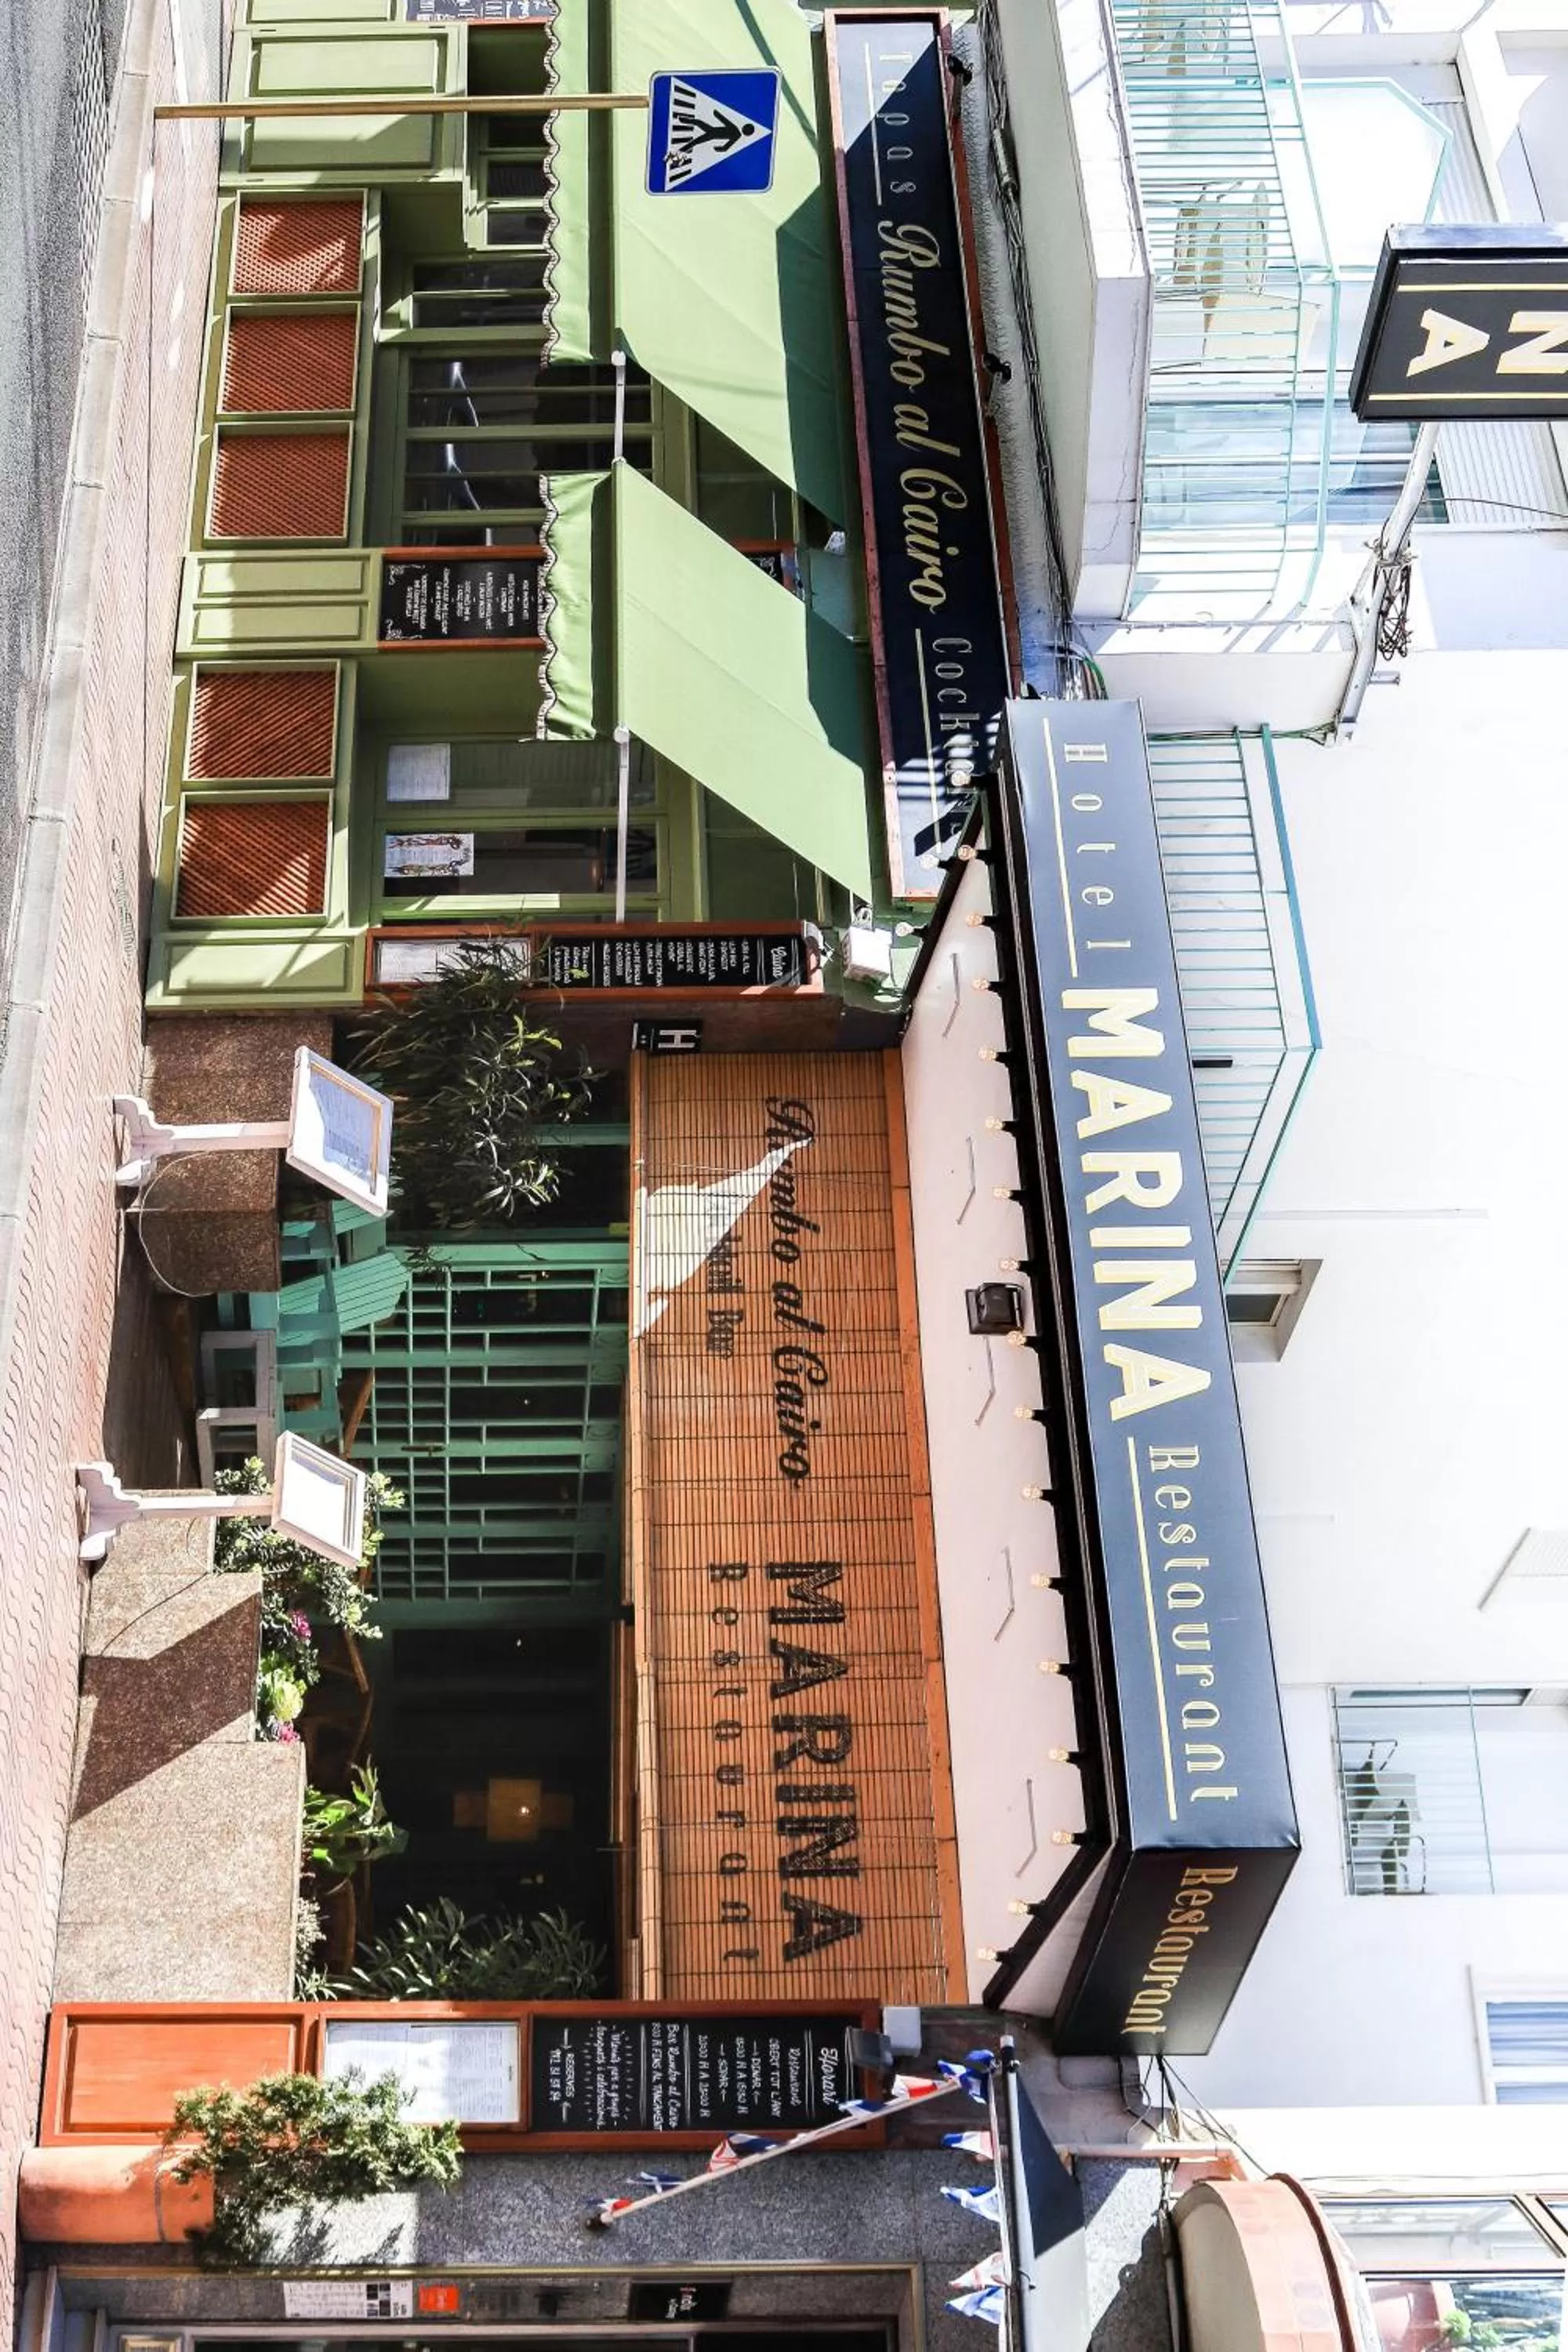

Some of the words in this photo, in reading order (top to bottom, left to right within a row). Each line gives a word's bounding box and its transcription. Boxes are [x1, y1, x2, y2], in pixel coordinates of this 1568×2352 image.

[876, 51, 916, 194] Tapas
[877, 220, 950, 391] Rumbo
[894, 403, 960, 457] al
[899, 468, 968, 614] Cairo
[1063, 743, 1131, 950] Hotel
[659, 1029, 697, 1048] H
[1061, 986, 1212, 1421] MARINA
[706, 1308, 745, 1360] Bar
[771, 1281, 826, 1336] al
[773, 1345, 829, 1489] Cairo
[1149, 1444, 1239, 1802] Restaurant
[710, 1562, 760, 1962] Restaurant
[768, 1561, 862, 1962] MARINA
[1120, 1866, 1239, 2036] Restaurant
[818, 2047, 838, 2104] Horari
